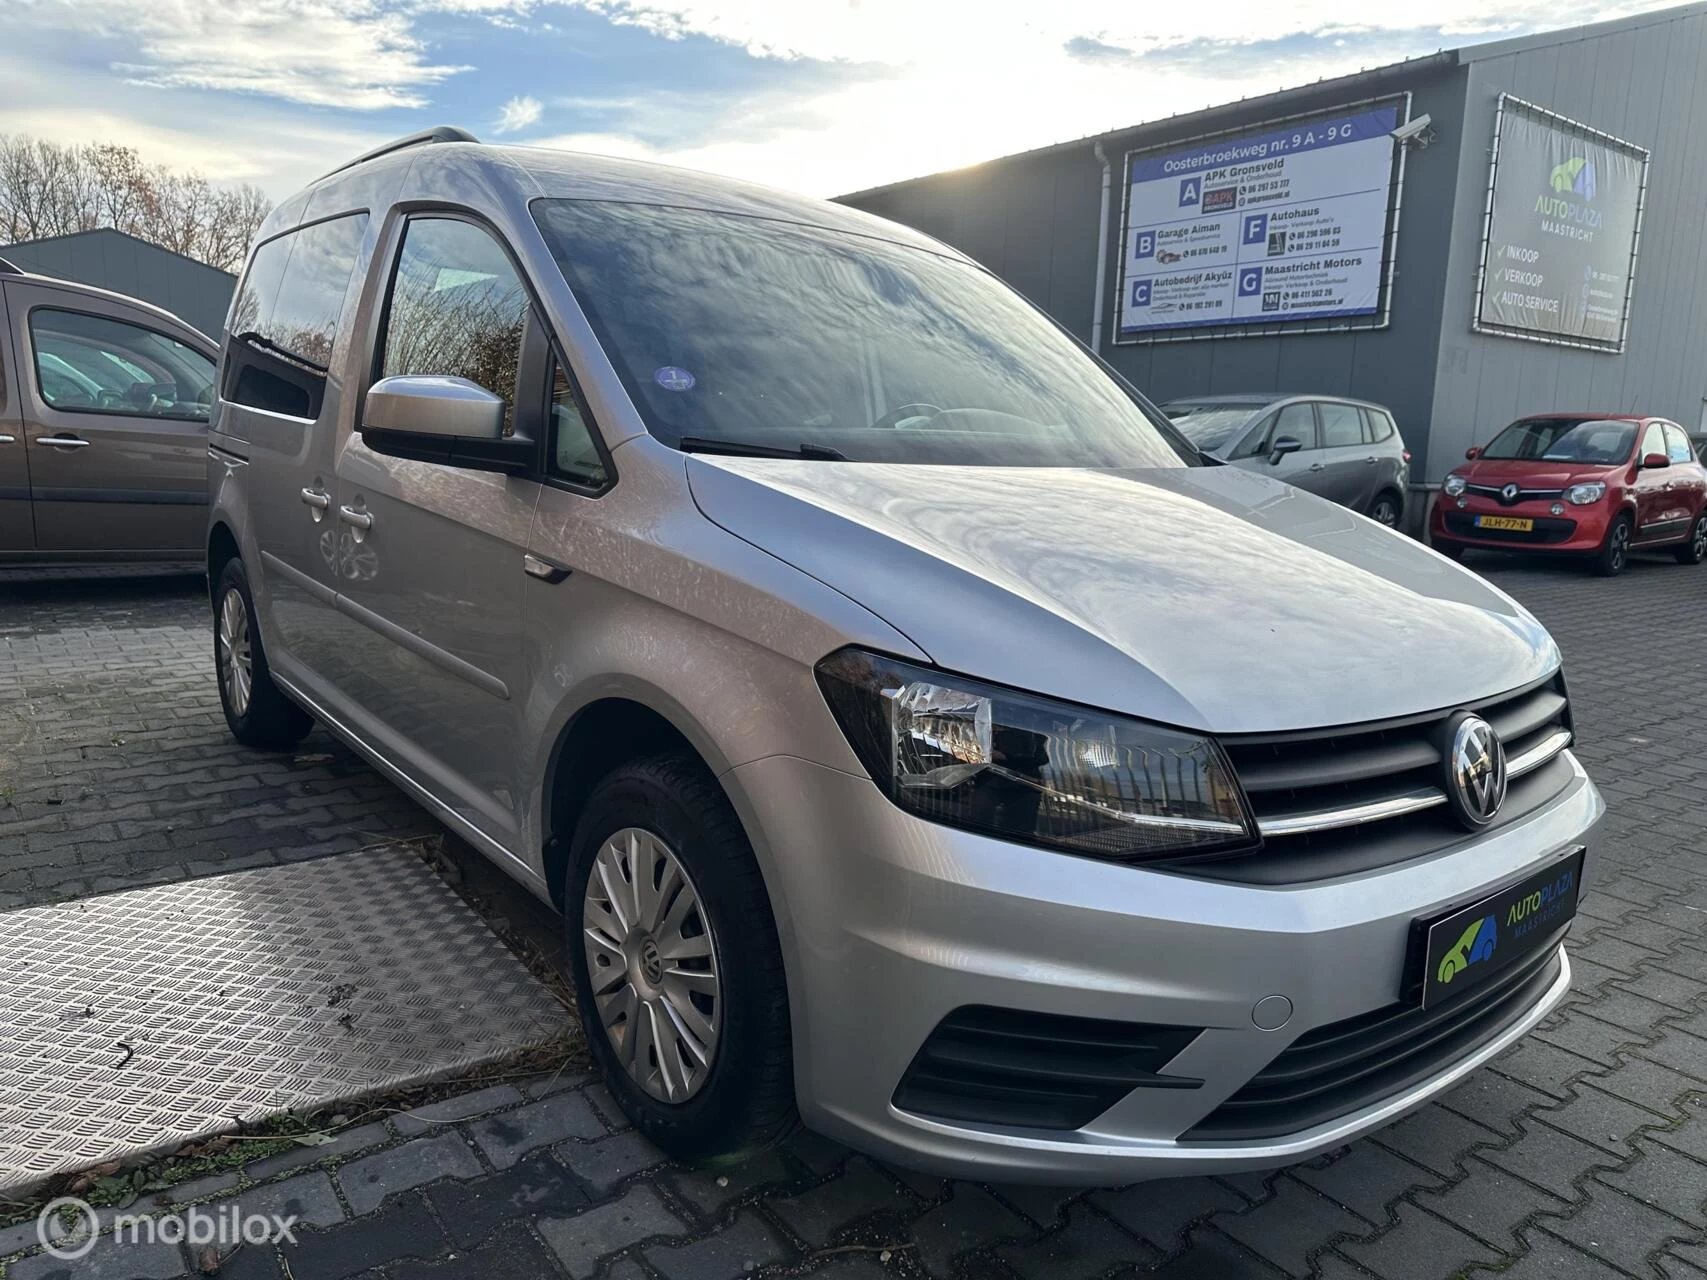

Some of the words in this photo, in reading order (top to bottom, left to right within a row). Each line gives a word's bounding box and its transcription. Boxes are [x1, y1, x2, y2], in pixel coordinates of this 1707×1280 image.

[1164, 141, 1267, 173] Oosterbroekweg
[1271, 138, 1289, 152] nr.
[1292, 134, 1301, 147] 9
[1303, 131, 1315, 145] A
[1327, 126, 1336, 140] 9
[1341, 123, 1352, 137] G
[1204, 169, 1225, 181] APK
[1230, 159, 1284, 176] Gronsveld
[1182, 183, 1197, 201] A
[1270, 207, 1319, 221] Autohaus
[1157, 228, 1188, 240] Garage
[1191, 223, 1220, 234] Aiman
[1249, 220, 1261, 238] F
[1541, 219, 1594, 243] MAASTRICHT
[1139, 236, 1151, 252] B
[1507, 245, 1539, 264] INKOOP
[1265, 261, 1320, 275] Maastricht
[1323, 257, 1362, 269] Motors
[1153, 275, 1202, 287] Autobedrijf
[1242, 273, 1257, 289] G
[1504, 267, 1543, 288] VERKOOP
[1135, 285, 1146, 302] C
[1501, 290, 1525, 309] AUTO
[1524, 293, 1559, 313] SERVICE
[1482, 517, 1527, 529] JLH-77-N
